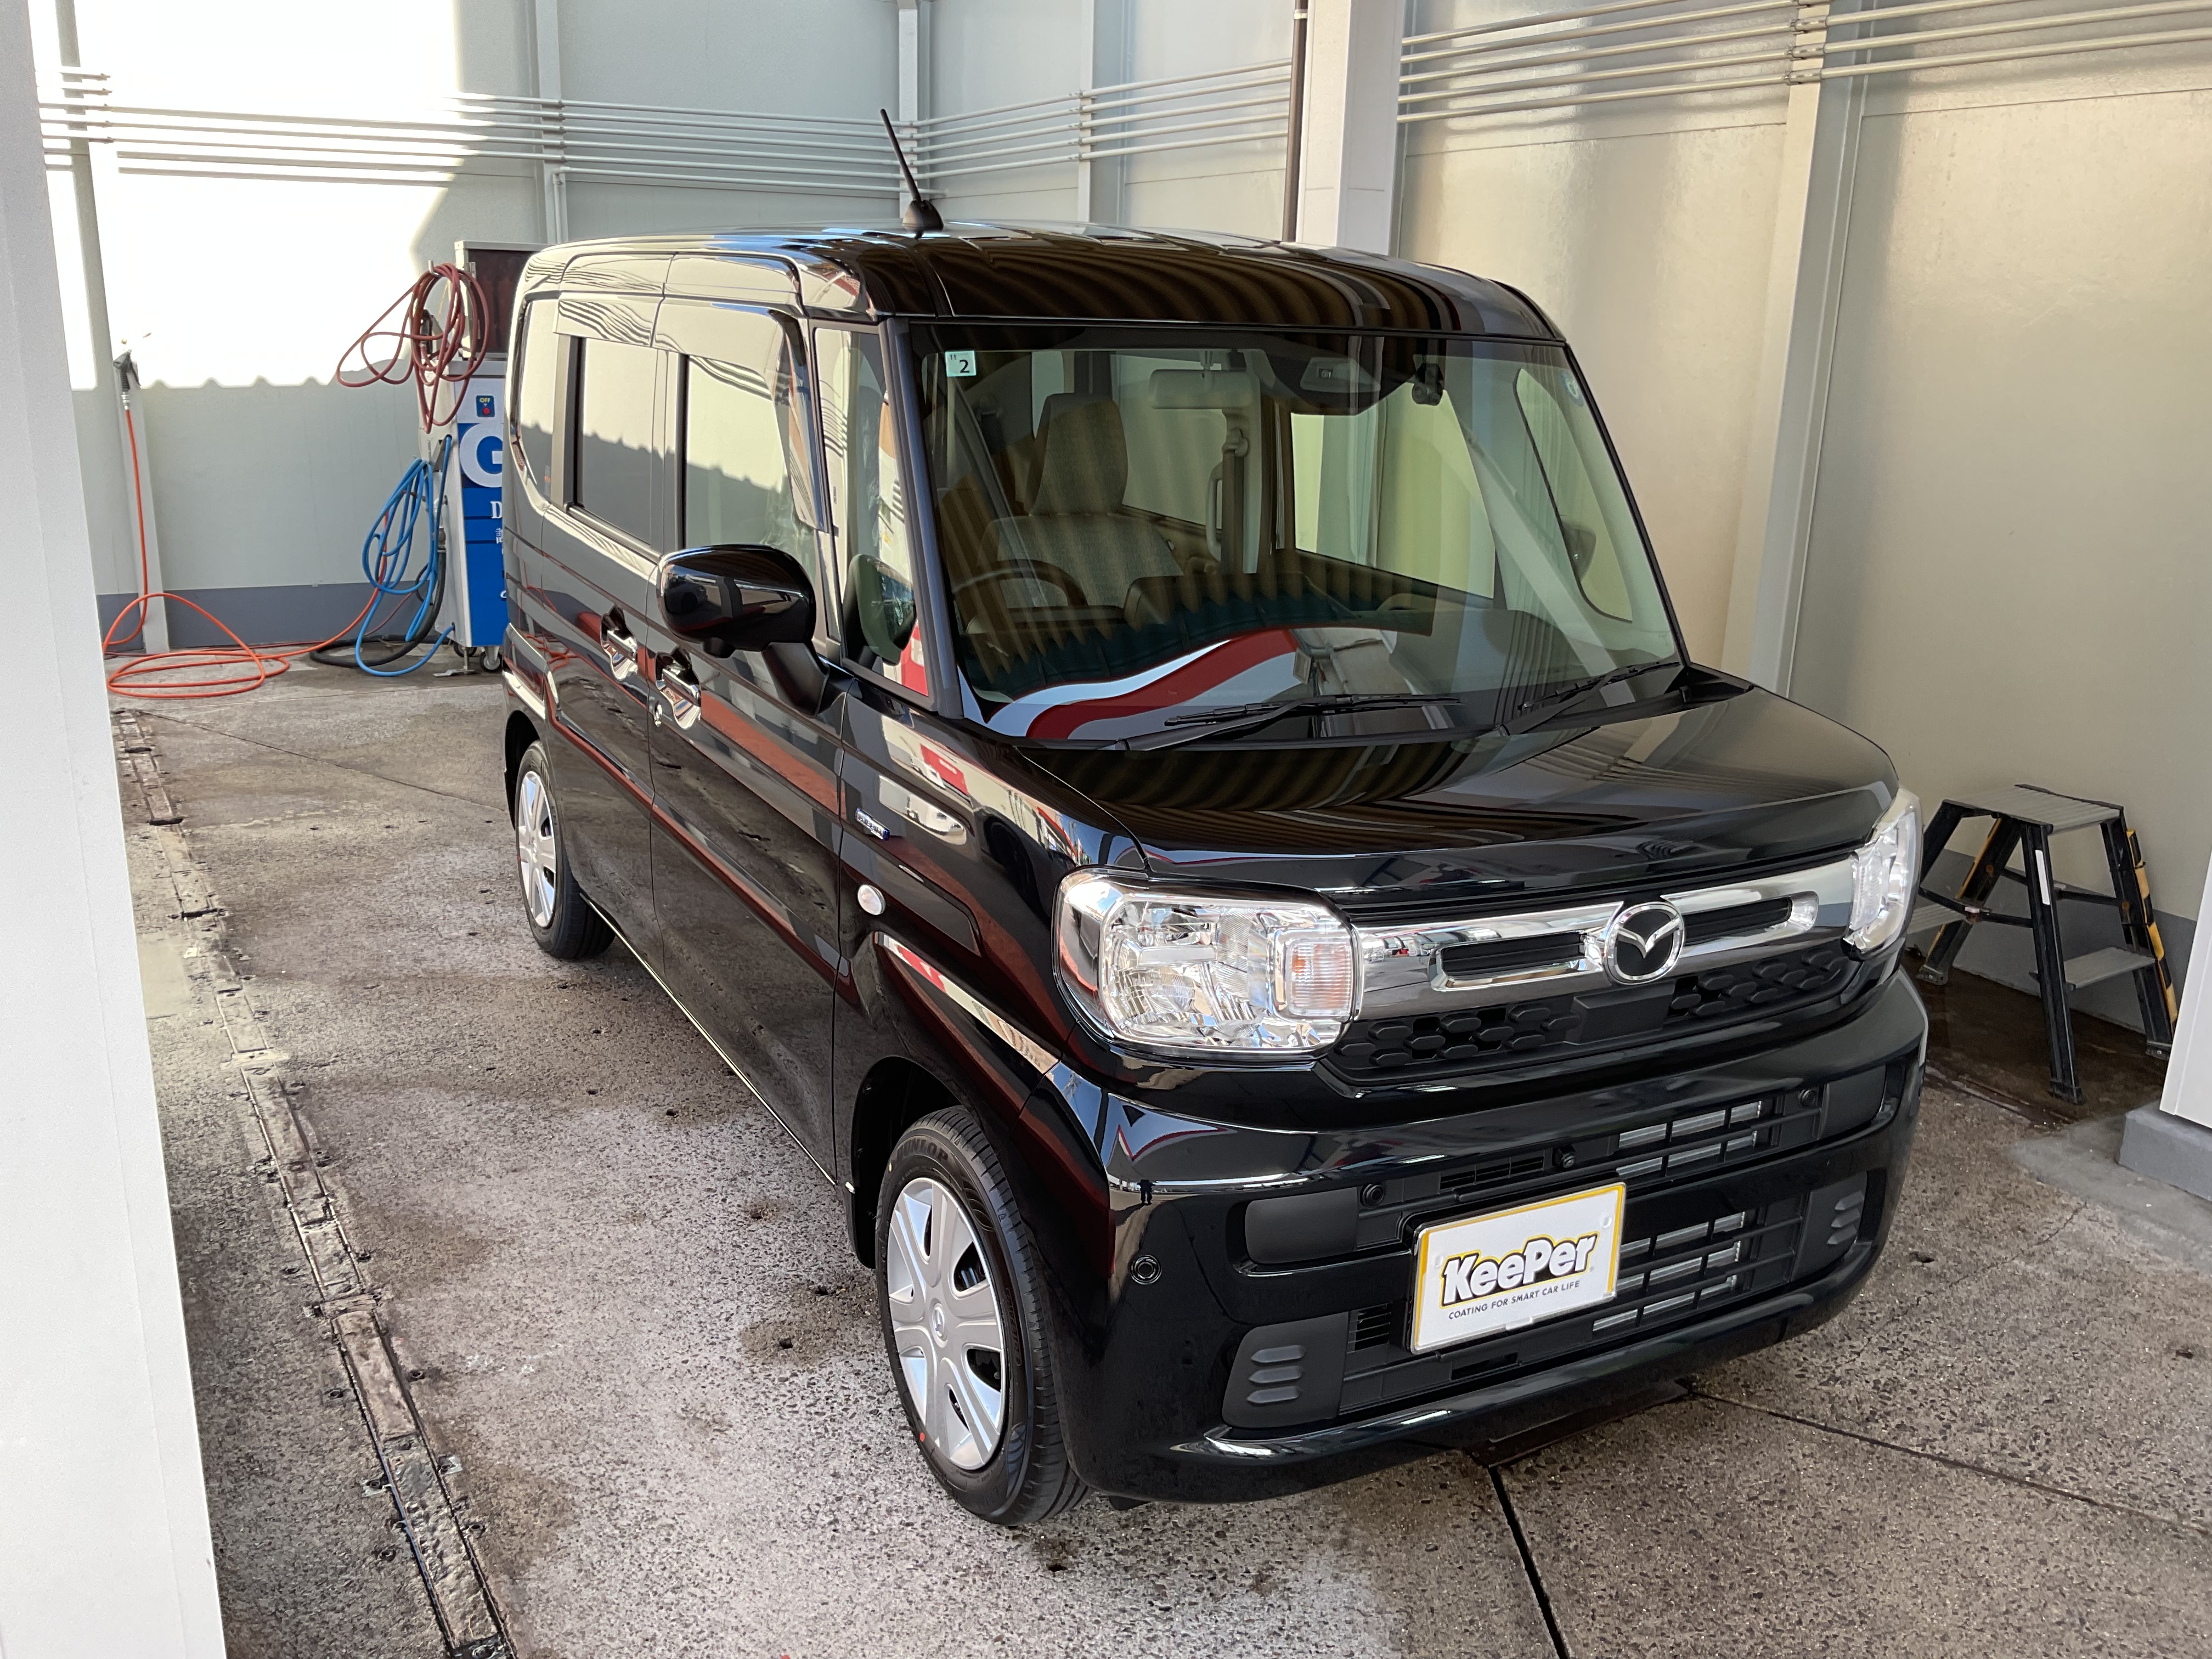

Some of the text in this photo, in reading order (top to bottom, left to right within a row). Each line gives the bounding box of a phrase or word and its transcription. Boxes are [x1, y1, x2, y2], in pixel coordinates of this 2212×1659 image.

[959, 359, 970, 374] 2
[1441, 1233, 1599, 1307] KeePer
[1448, 1280, 1580, 1319] COATING FOR SMART CAR LIFE
